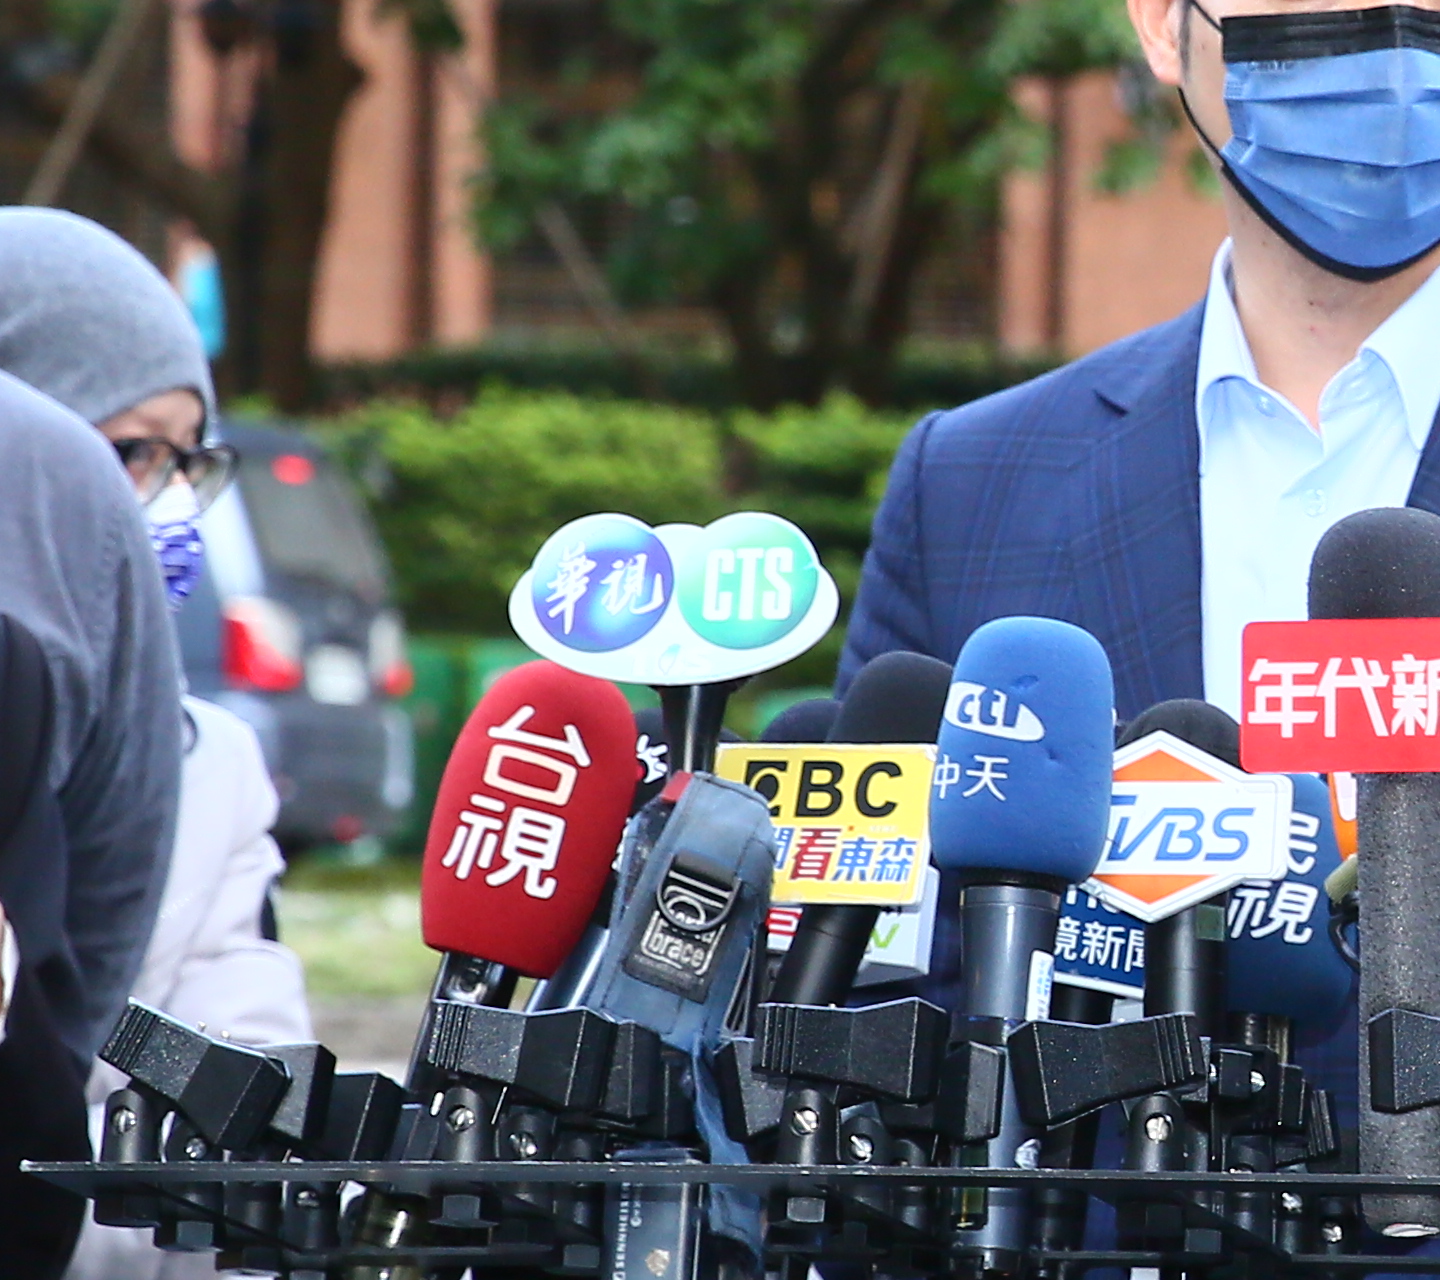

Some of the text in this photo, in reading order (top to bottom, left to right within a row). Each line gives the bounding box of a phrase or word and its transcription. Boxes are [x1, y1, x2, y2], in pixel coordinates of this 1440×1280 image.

[545, 541, 665, 635] 華視
[702, 546, 794, 622] CTS
[441, 705, 591, 899] 台視
[934, 754, 1010, 802] 中天
